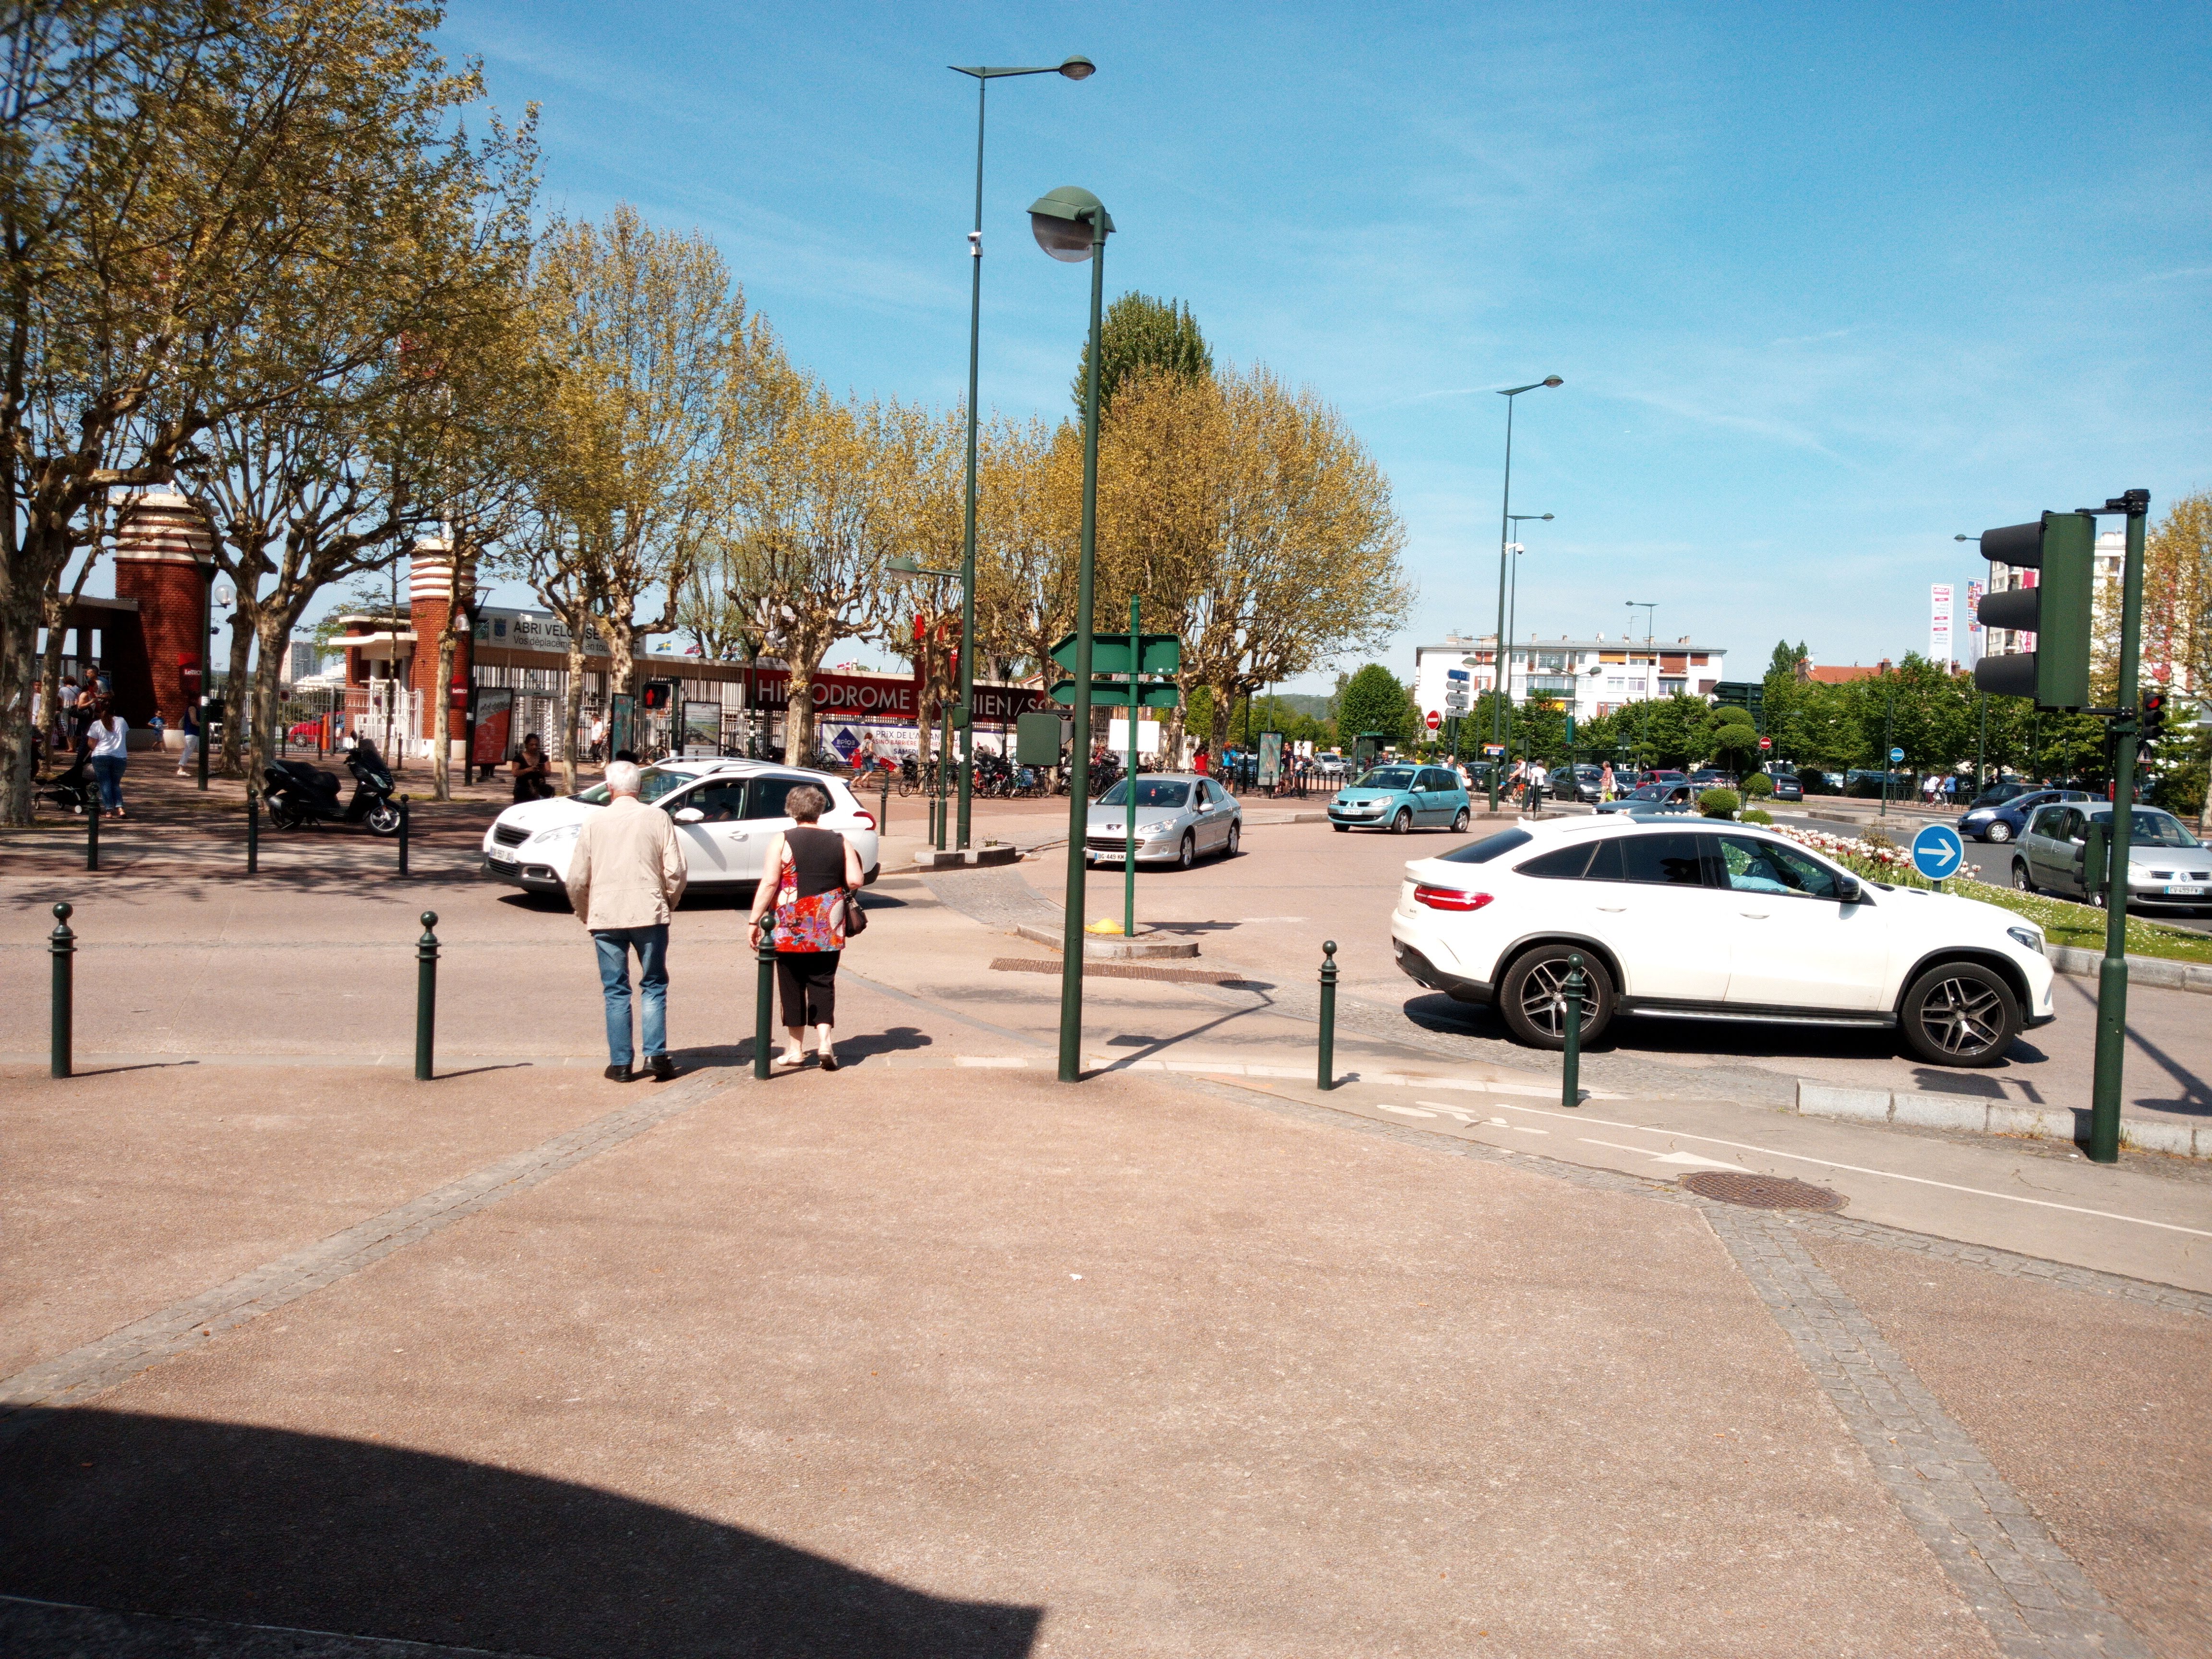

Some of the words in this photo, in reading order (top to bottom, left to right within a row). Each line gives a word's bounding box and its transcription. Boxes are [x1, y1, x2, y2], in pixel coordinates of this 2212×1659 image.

[514, 621, 541, 635] ABRI
[514, 636, 528, 645] Vos
[530, 637, 583, 649] déplaceme
[759, 679, 910, 709] HIODROME
